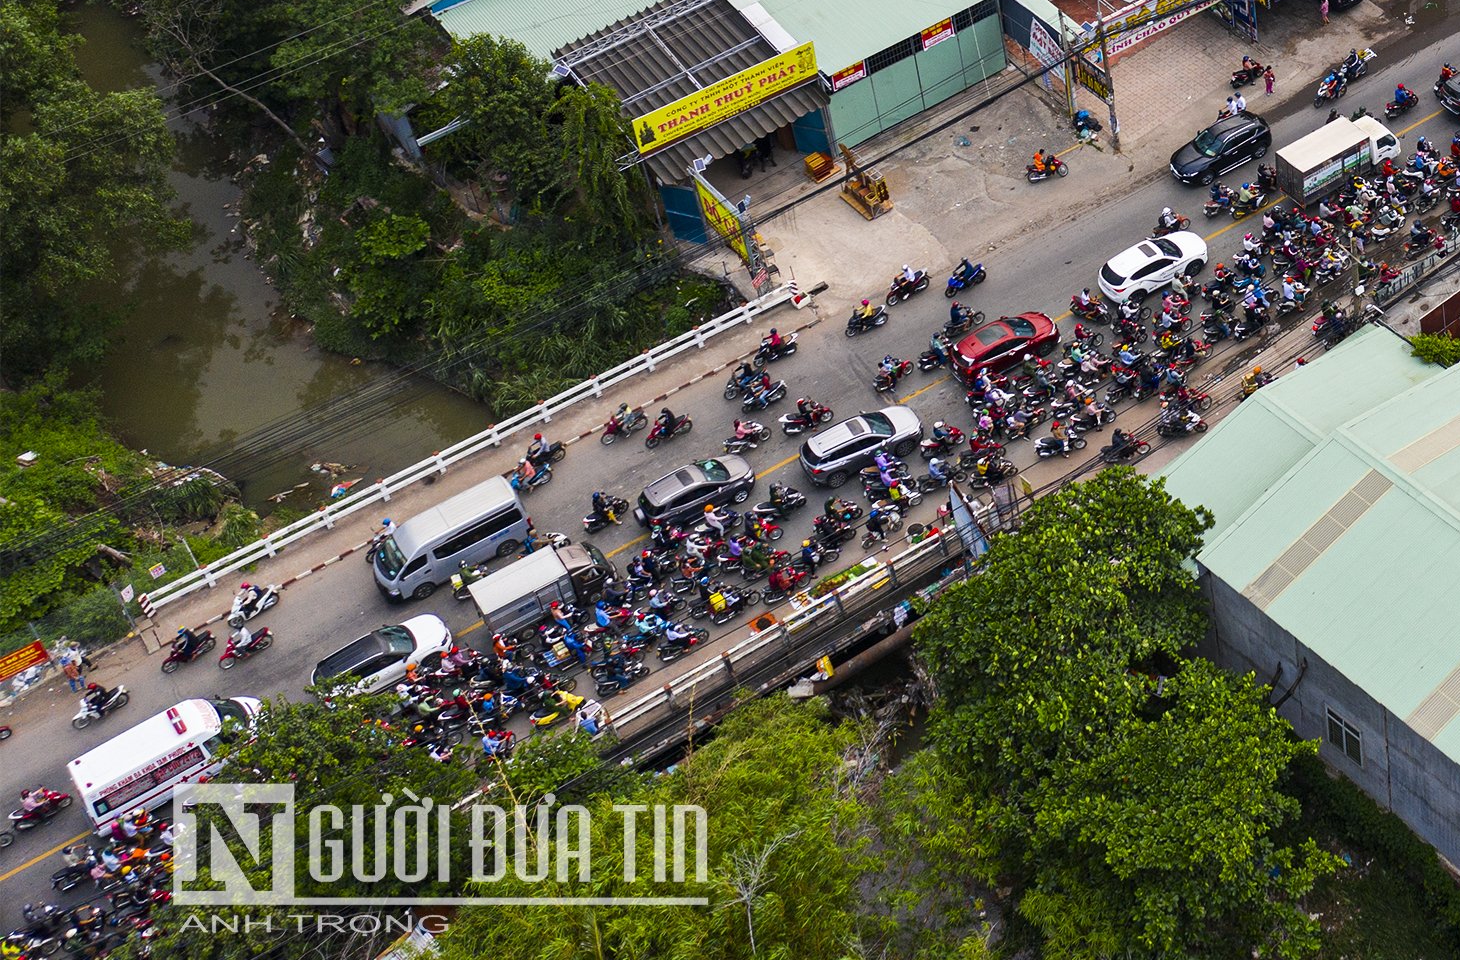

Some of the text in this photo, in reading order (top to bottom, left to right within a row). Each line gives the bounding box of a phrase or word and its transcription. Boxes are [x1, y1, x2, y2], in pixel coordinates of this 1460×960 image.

[658, 103, 710, 133] THANH
[758, 64, 797, 87] PHÁT
[666, 60, 785, 118] CÔNG TY TNHH MỘT THÀNH VIÊN
